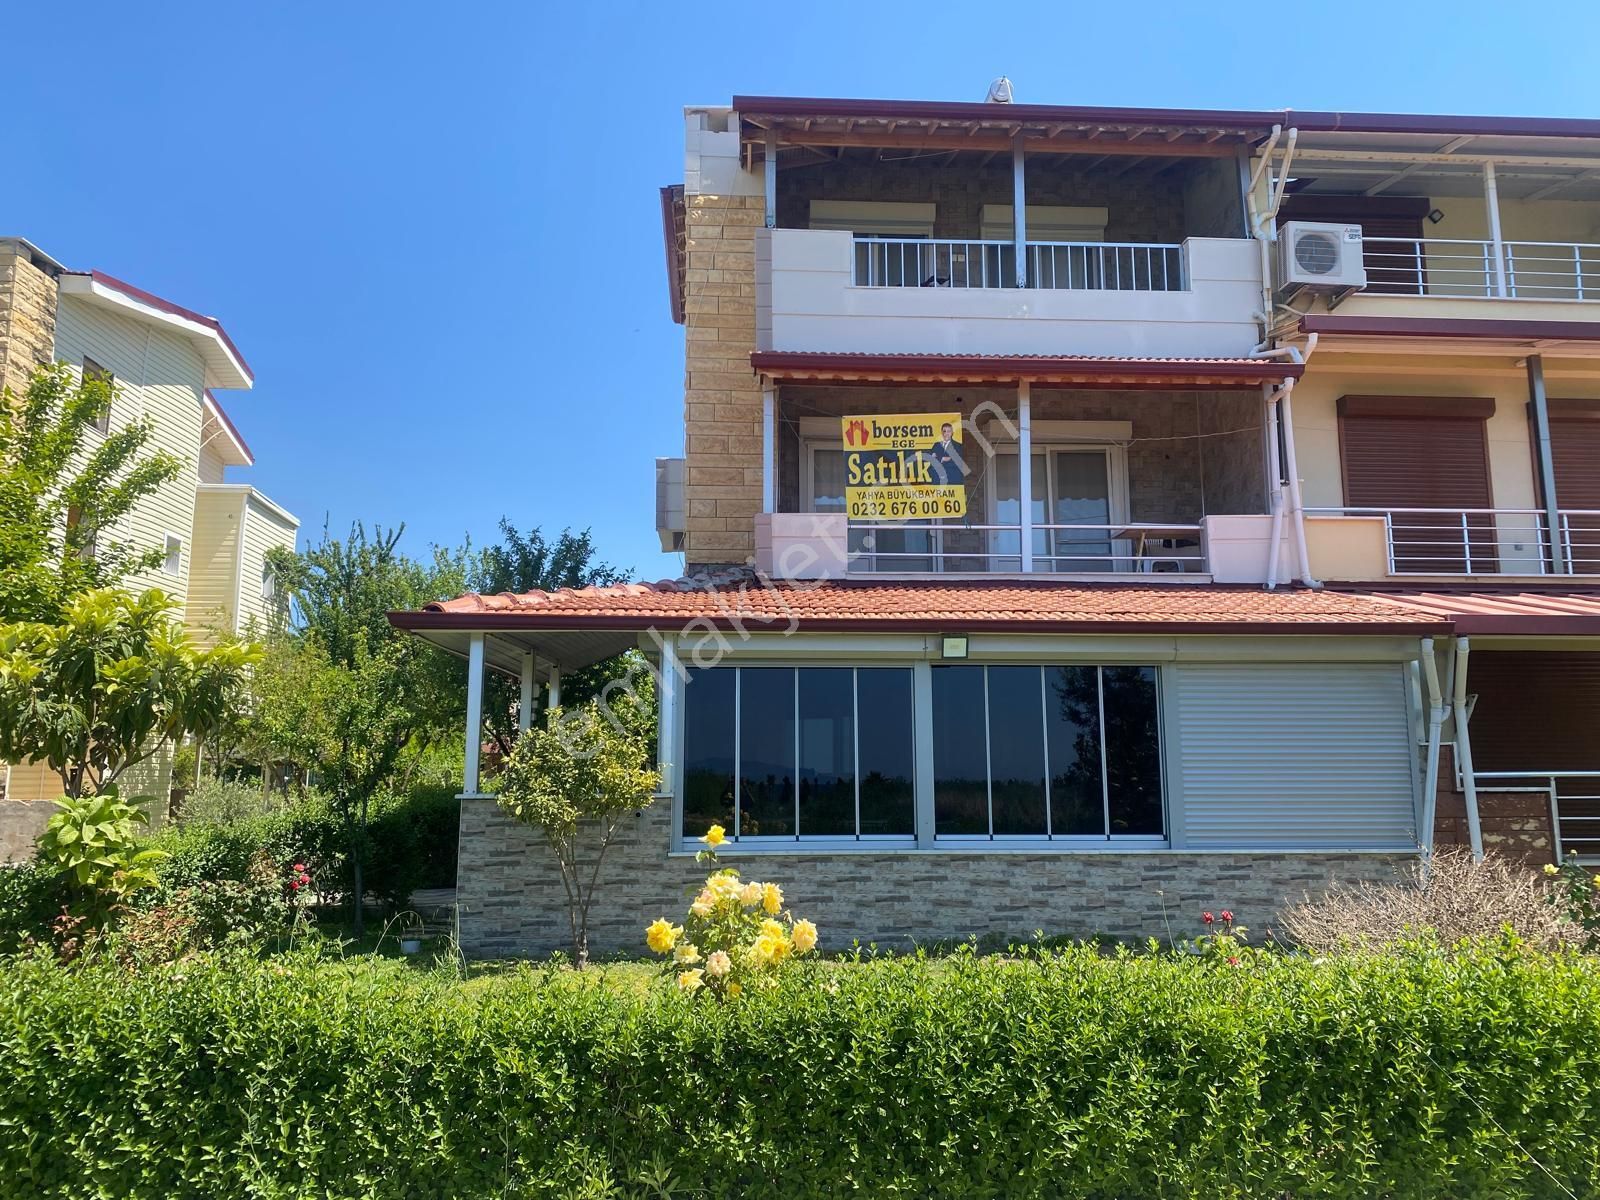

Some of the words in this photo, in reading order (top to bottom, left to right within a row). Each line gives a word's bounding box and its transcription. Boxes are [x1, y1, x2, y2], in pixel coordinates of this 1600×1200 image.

[872, 420, 933, 438] borsem
[892, 440, 915, 448] EGE
[848, 451, 932, 484] Satılık
[857, 491, 885, 500] YAHYA
[888, 489, 955, 499] BÜYÜKBAYRAM
[852, 502, 886, 516] 0232
[891, 501, 917, 515] 676
[922, 500, 939, 514] 00
[944, 500, 961, 513] 60
